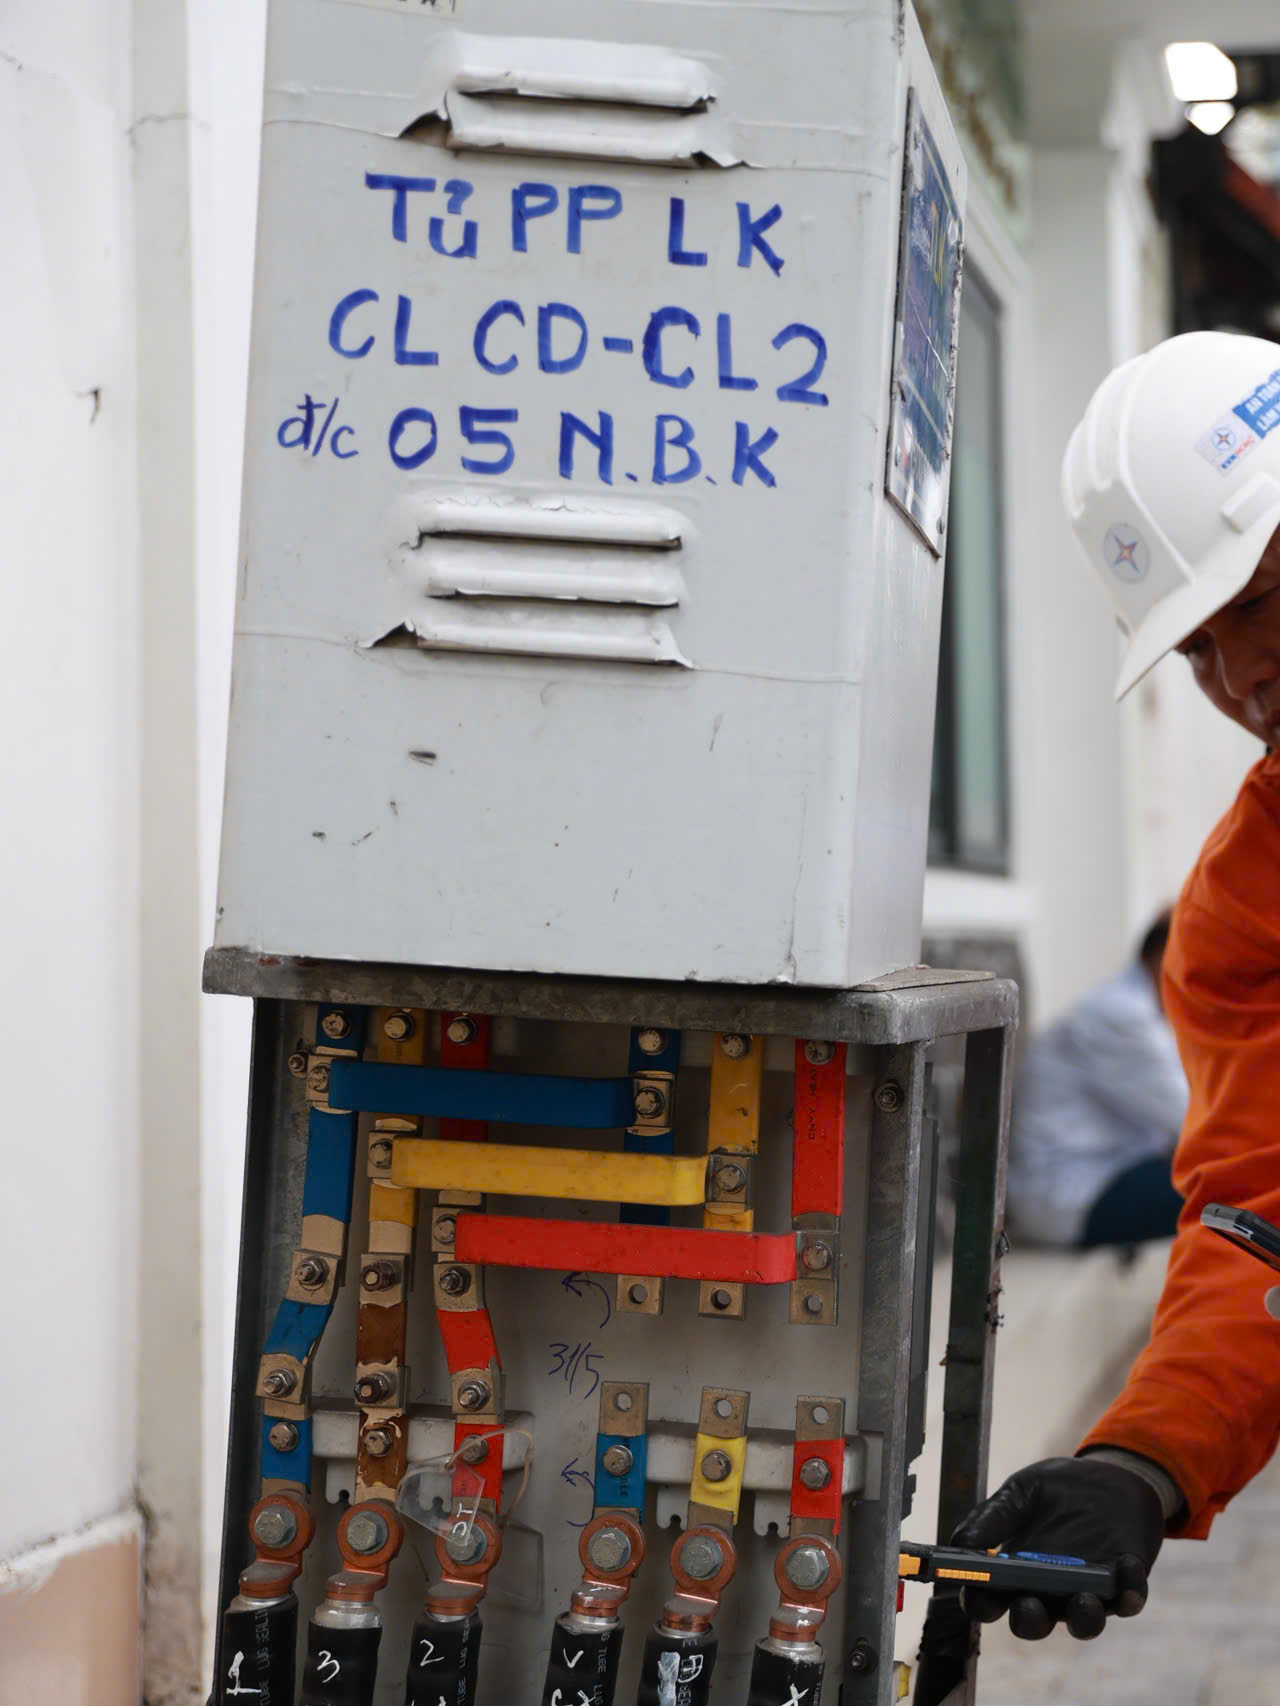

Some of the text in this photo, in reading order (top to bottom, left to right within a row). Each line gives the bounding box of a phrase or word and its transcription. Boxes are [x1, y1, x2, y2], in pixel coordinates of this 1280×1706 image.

[365, 172, 478, 258] Tủ
[511, 182, 623, 253] PP
[328, 288, 439, 366] CL
[389, 406, 518, 475] 05
[316, 1650, 341, 1683] 3
[420, 1639, 445, 1667] 2
